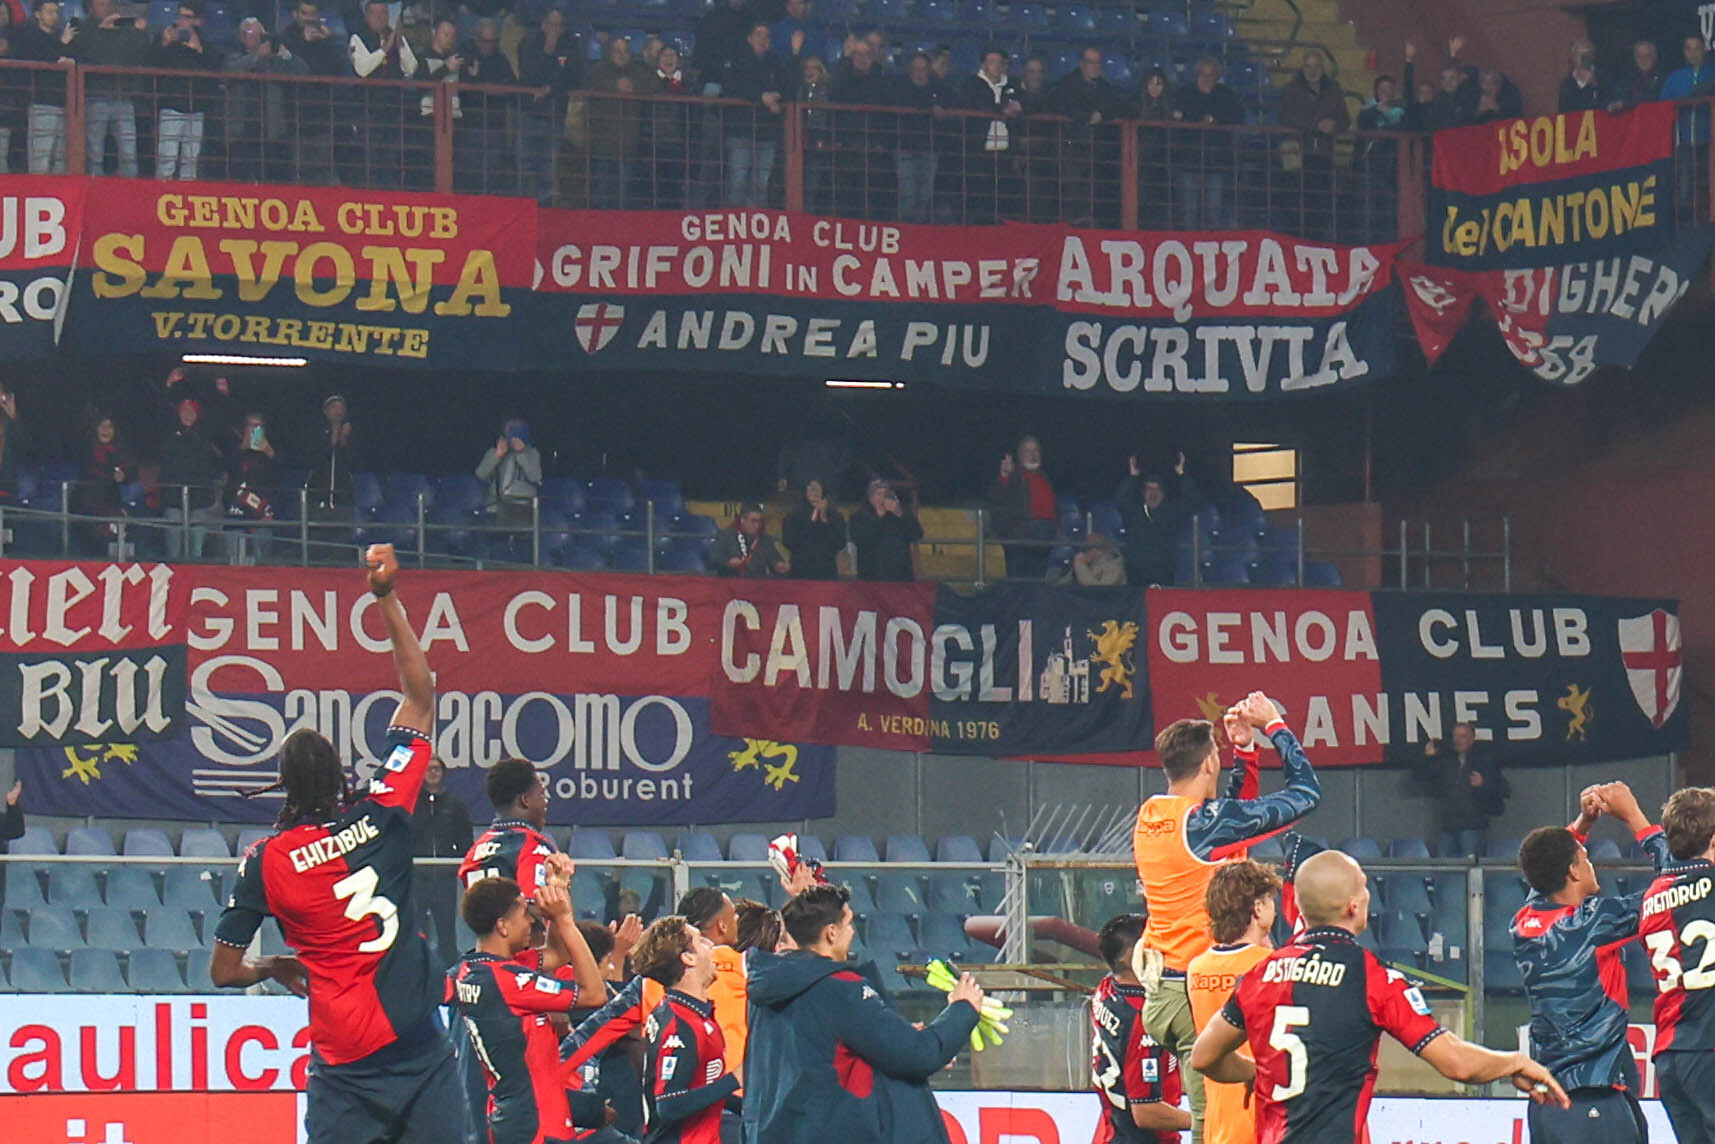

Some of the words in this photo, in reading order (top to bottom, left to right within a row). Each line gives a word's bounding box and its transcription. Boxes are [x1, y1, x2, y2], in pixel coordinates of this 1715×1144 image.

[1500, 109, 1598, 175] ISOLA
[156, 194, 325, 233] GENOA
[337, 201, 458, 239] CLUB
[681, 212, 791, 243] GENOA
[812, 220, 900, 254] CLUB
[1491, 175, 1656, 253] CANTONE
[92, 232, 511, 319] SAVONA
[551, 244, 772, 288] GRIFONI
[831, 254, 1040, 300] CAMPER
[1056, 235, 1381, 323] ARQUATA
[636, 309, 878, 358] ANDREA
[900, 321, 991, 368] PIU
[1062, 320, 1370, 393] SCRIVIA
[187, 587, 470, 654] GENOA
[504, 590, 692, 656] CLUB
[720, 598, 1033, 703] CAMOGLI
[1158, 610, 1379, 664] GENOA
[1418, 608, 1592, 659] CLUB
[956, 720, 1000, 740] 1976
[289, 814, 380, 874] EHIZIBUE
[332, 865, 400, 953] 3
[1269, 1005, 1310, 1102] 5
